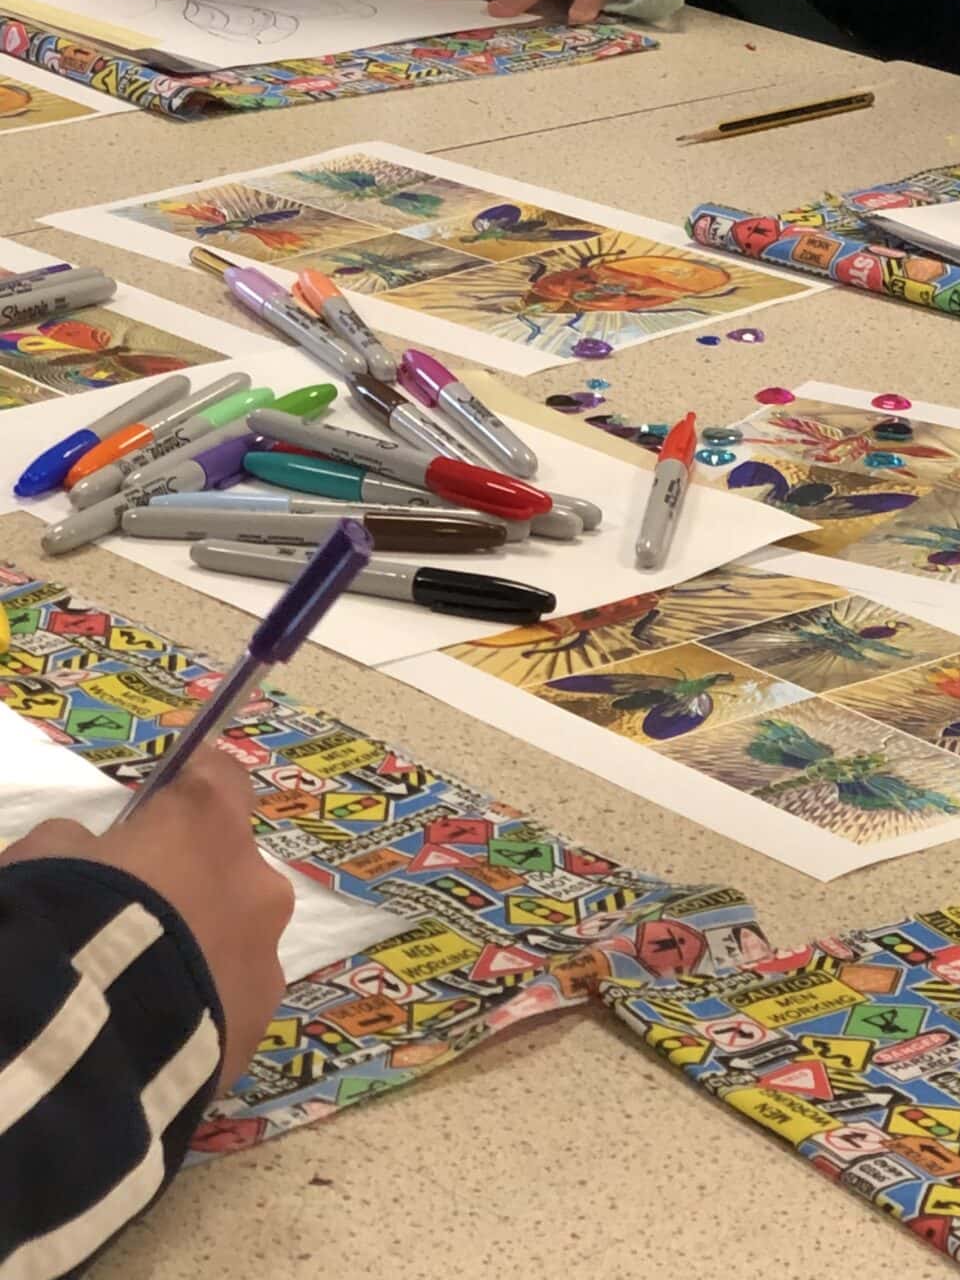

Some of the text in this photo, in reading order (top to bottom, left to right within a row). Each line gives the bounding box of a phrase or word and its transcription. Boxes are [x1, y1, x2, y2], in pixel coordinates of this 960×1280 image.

[322, 747, 355, 761] MEN
[540, 874, 573, 891] NOT
[402, 943, 442, 959] MEN
[405, 948, 475, 979] WORKING
[731, 971, 830, 1006] CAUTION
[776, 991, 819, 1007] MEN
[767, 994, 856, 1024] WORKING
[874, 1034, 949, 1062] DANGER
[891, 1043, 960, 1072] HARD HAT
[919, 1056, 959, 1072] AREA
[753, 1102, 793, 1125] MEN
